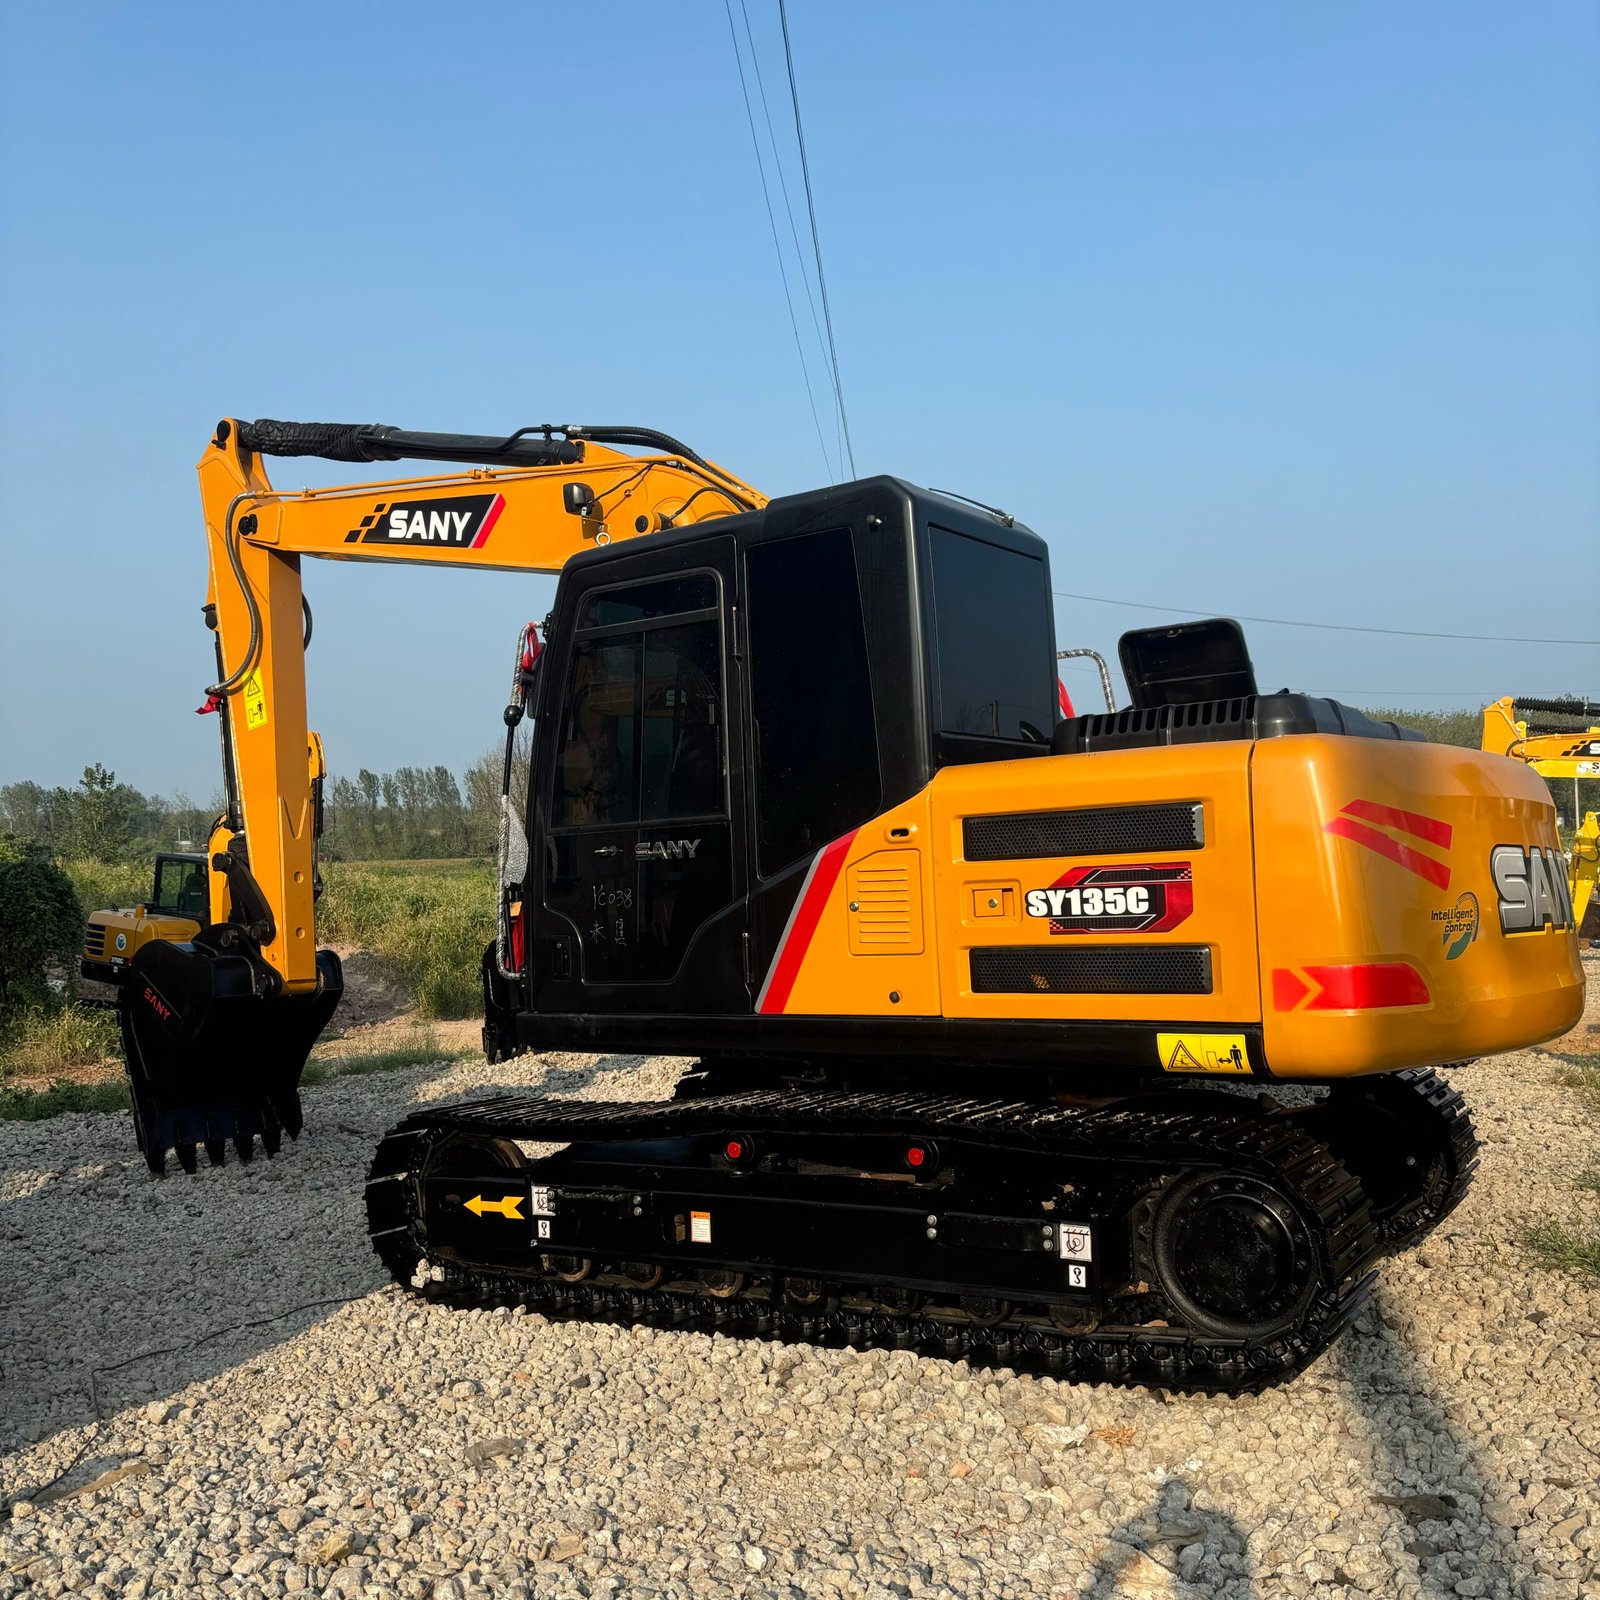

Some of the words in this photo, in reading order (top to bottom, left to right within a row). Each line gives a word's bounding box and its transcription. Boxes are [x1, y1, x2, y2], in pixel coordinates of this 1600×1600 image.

[388, 509, 472, 541] SANY
[635, 839, 701, 860] SANY
[1027, 886, 1150, 917] SY135C
[1431, 905, 1474, 922] Intelligent
[1444, 922, 1474, 933] control
[144, 988, 171, 1020] SANY
